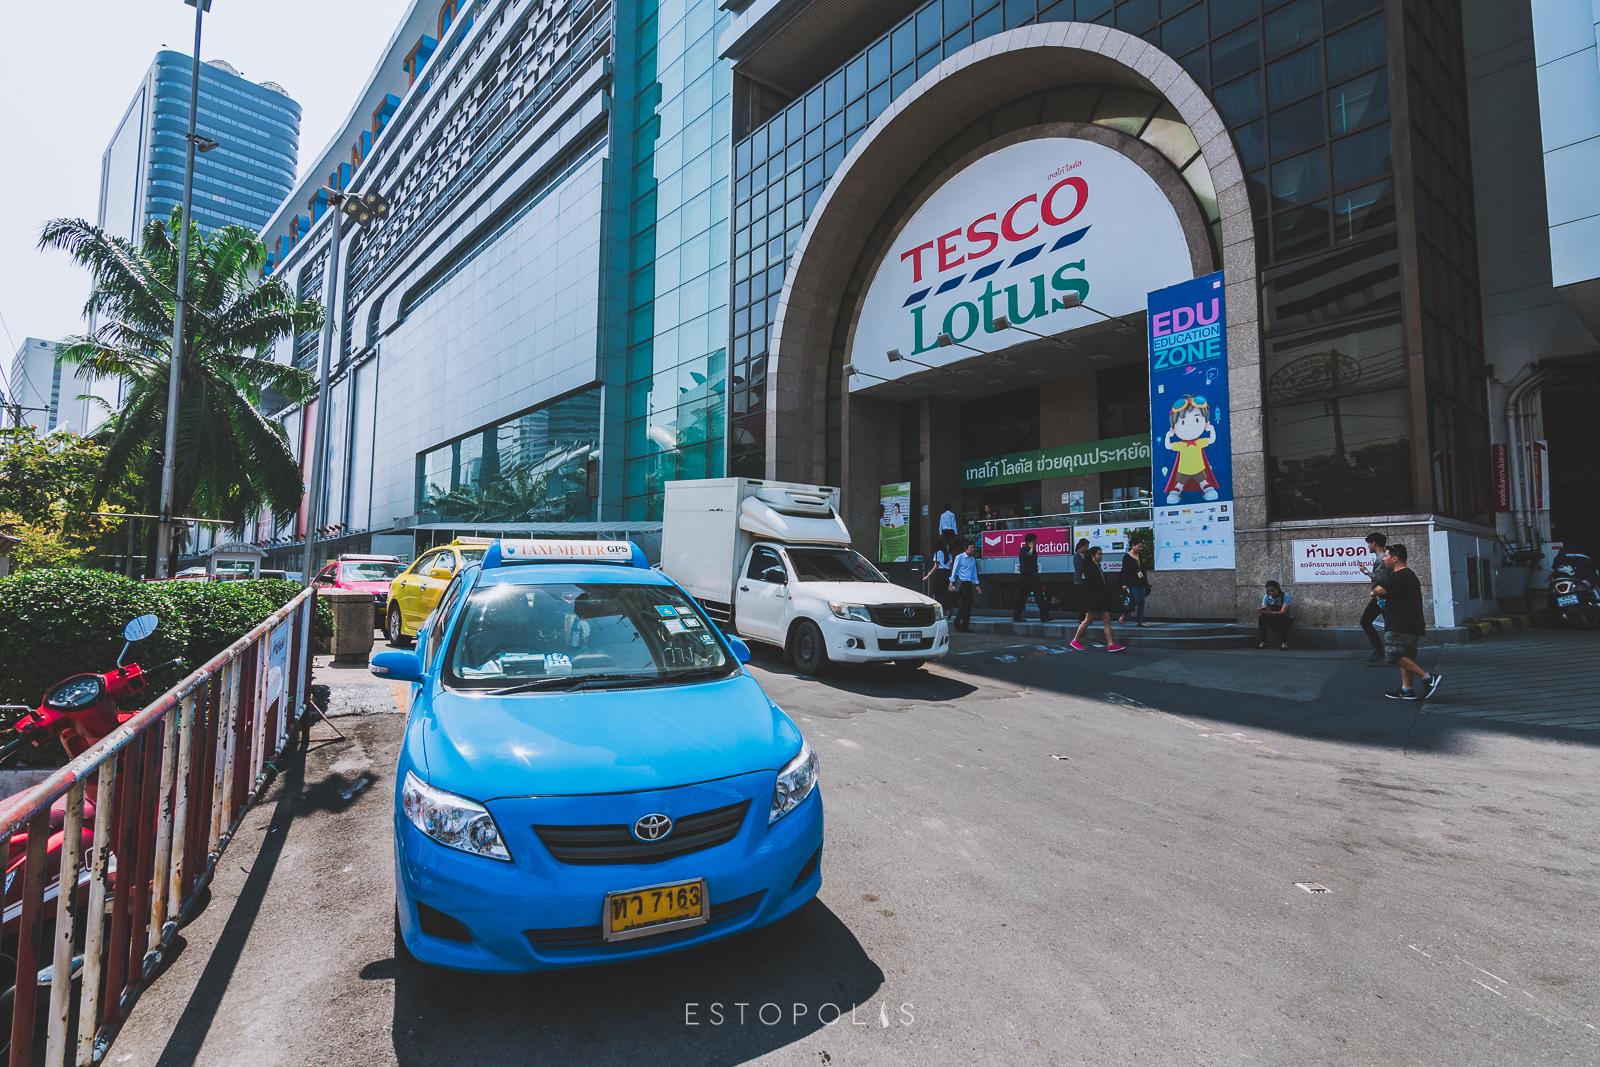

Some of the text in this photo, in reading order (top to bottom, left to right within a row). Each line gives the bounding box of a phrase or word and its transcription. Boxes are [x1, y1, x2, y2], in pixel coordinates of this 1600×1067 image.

[900, 176, 1089, 284] TESCO
[910, 258, 1091, 356] Lotus
[1152, 297, 1220, 337] EDU
[1154, 325, 1220, 349] EDUCATION
[1153, 337, 1221, 370] ZONE
[966, 441, 1151, 481] เทสโก้ โลตัส ช่วยคุณประหยัด
[521, 544, 628, 556] TAXI-METER GPS
[1300, 560, 1347, 568] รถจักรยานยนต์
[1306, 544, 1367, 558] ห้ามจอด
[651, 886, 700, 913] 7163
